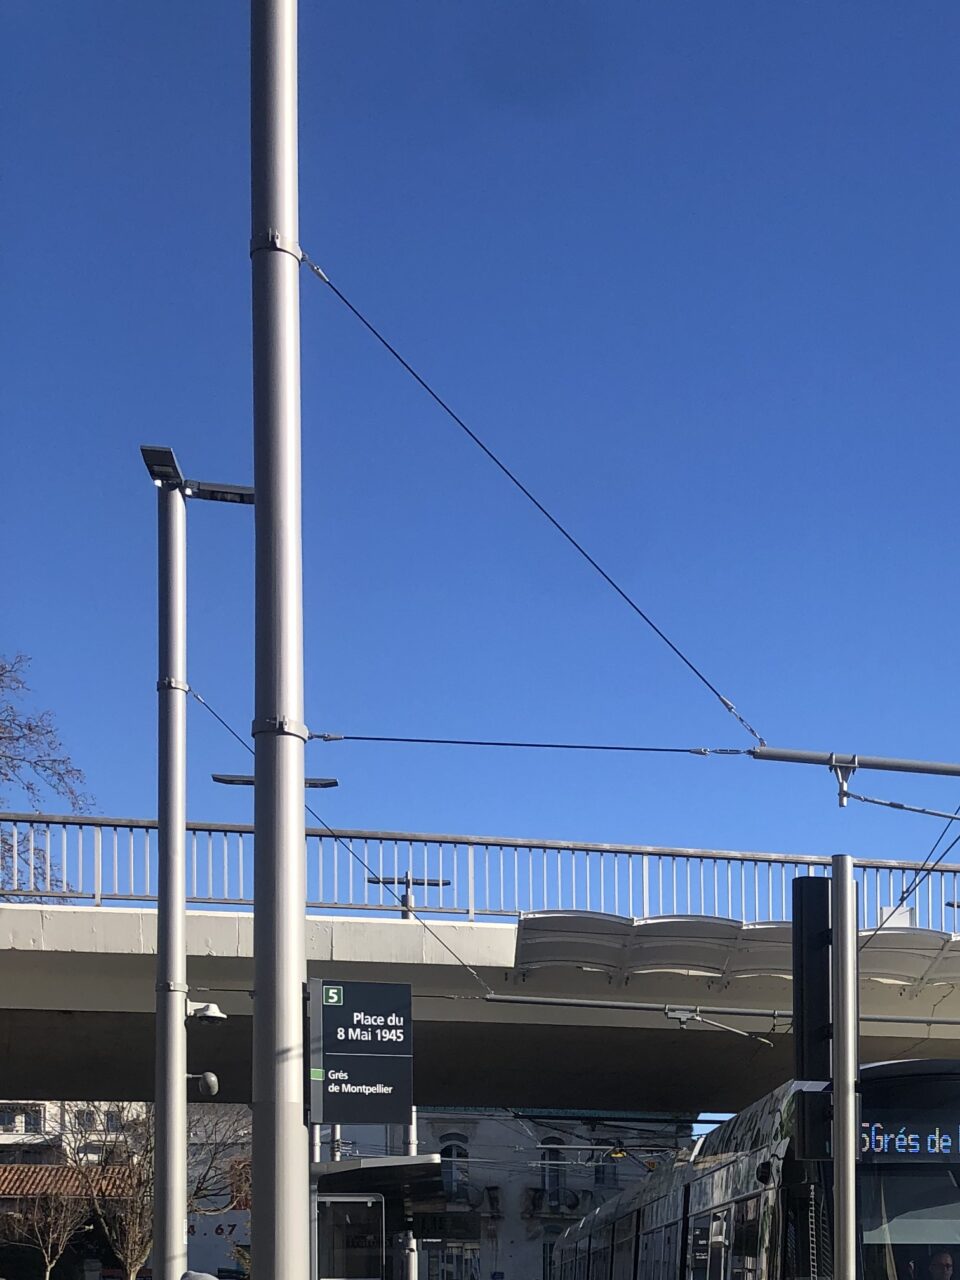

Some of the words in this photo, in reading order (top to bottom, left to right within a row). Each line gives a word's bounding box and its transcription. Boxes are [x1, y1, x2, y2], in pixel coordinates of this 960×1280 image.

[328, 989, 338, 1003] 5
[353, 1012, 385, 1026] Place
[387, 1013, 404, 1027] du
[336, 1027, 346, 1040] 8
[348, 1028, 372, 1041] Mai
[376, 1029, 404, 1042] 1945
[328, 1083, 340, 1093] de
[342, 1083, 394, 1096] Montpellier
[927, 1127, 952, 1153] de
